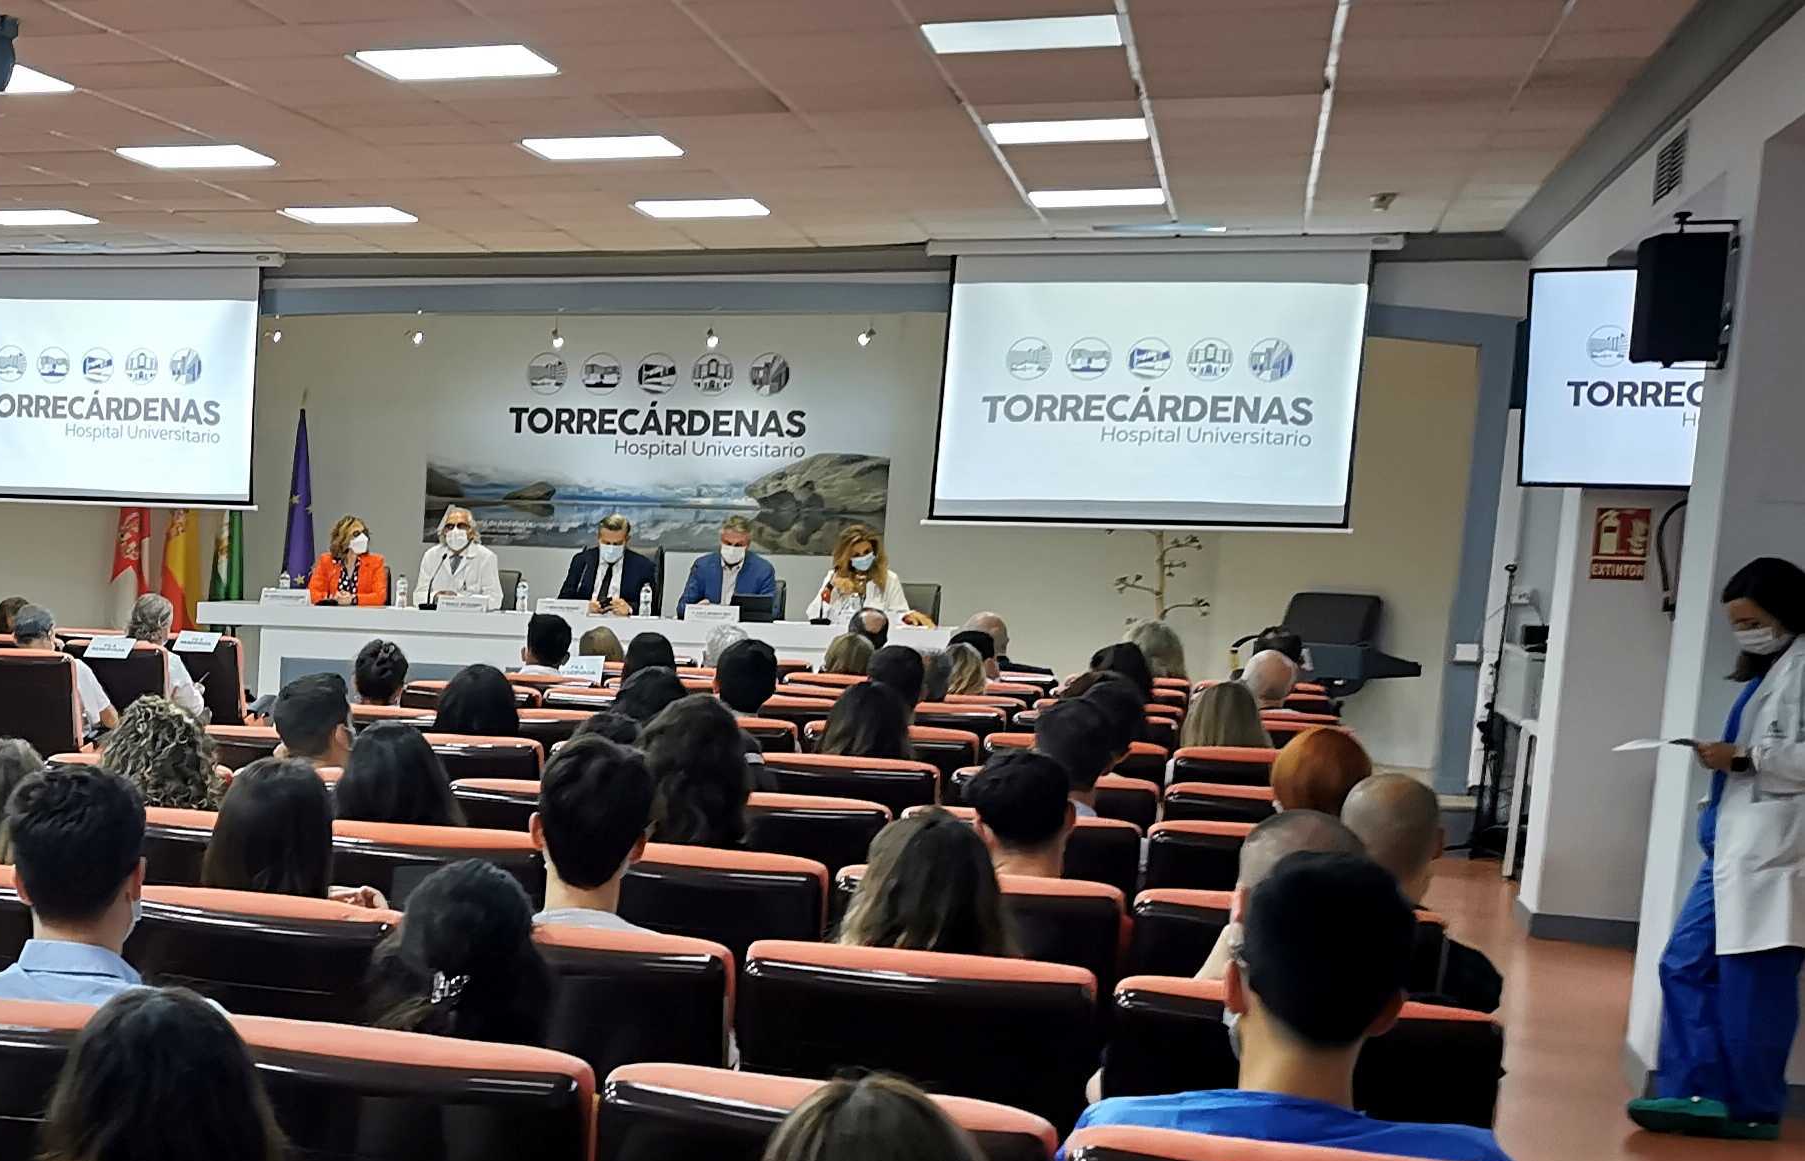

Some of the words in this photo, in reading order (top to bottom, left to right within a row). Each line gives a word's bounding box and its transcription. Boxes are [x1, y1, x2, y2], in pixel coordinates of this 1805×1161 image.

[981, 386, 1314, 427] TORRECÁRDENAS
[509, 400, 807, 438] TORRECÁRDENAS
[64, 423, 124, 441] Hospital
[127, 424, 221, 444] Universitario
[1100, 425, 1181, 447] Hospital
[1186, 427, 1312, 447] Universitario
[614, 439, 687, 459] Hospital
[691, 440, 806, 458] Universitario
[1591, 563, 1644, 577] EXTINTOR
